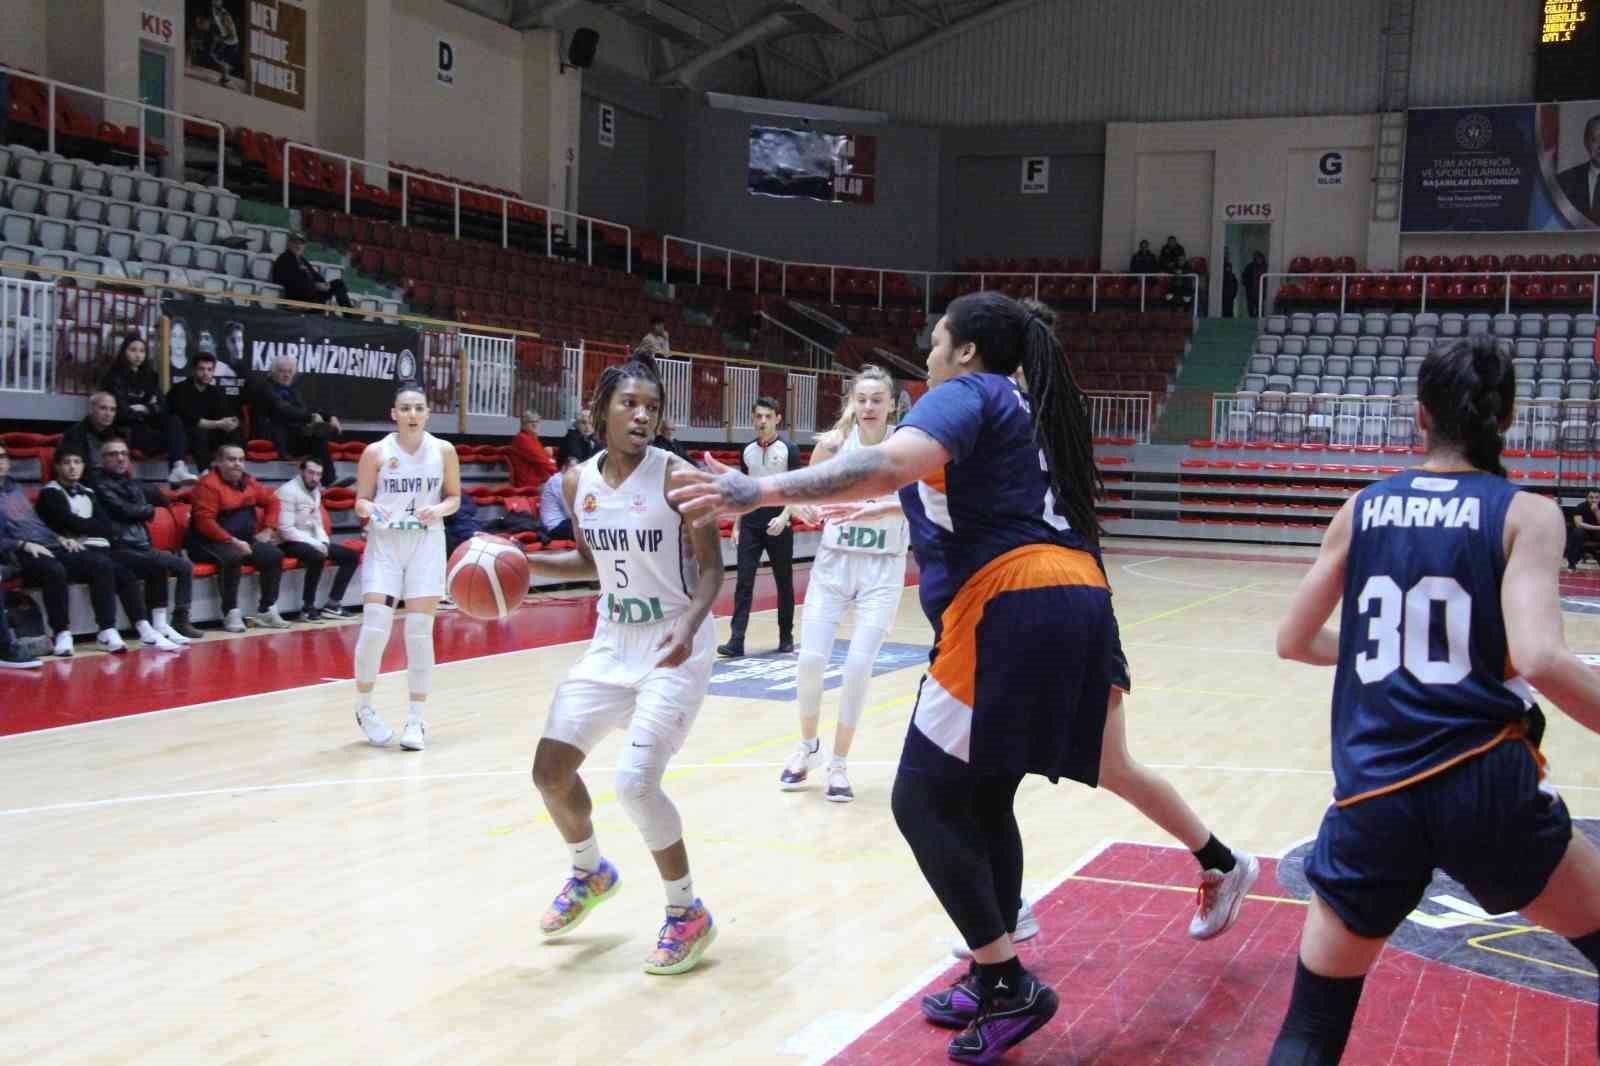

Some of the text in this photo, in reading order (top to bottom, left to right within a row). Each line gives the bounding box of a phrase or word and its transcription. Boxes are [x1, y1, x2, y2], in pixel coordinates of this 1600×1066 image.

[439, 41, 453, 71] D
[602, 106, 613, 134] E
[1027, 160, 1045, 182] F
[1319, 152, 1343, 176] G
[1225, 203, 1272, 220] ÇIKIŞ
[383, 477, 422, 494] YALOVA
[405, 497, 416, 516] 4
[1360, 495, 1481, 532] HARMA
[636, 528, 664, 553] VIP
[837, 525, 887, 549] HDI
[614, 559, 629, 589] 5
[607, 592, 665, 624] HDI
[1355, 575, 1473, 685] 30
